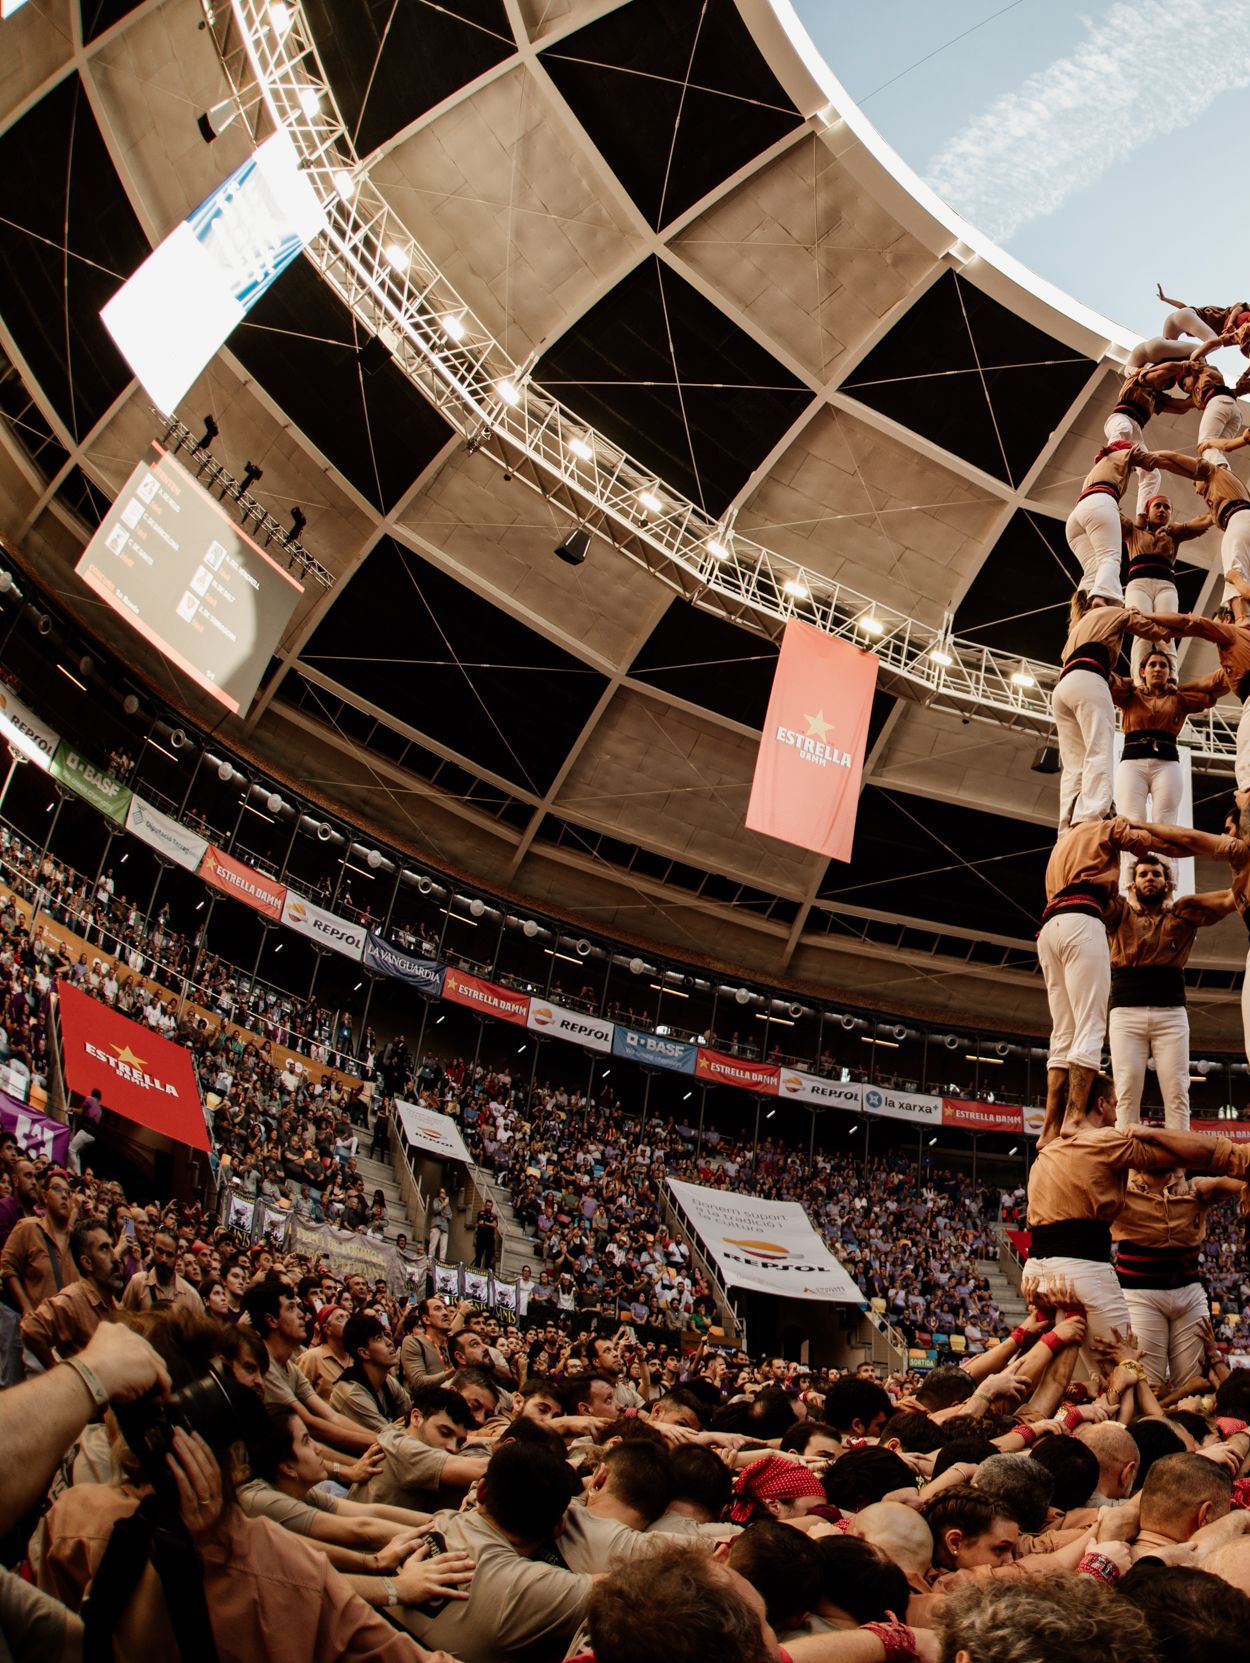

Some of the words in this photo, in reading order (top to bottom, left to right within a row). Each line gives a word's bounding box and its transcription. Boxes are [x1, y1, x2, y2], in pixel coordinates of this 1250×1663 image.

[776, 726, 851, 768] ESTRELLA
[799, 750, 827, 768] DAMM
[83, 765, 120, 797] BASF
[216, 865, 256, 895] ESTRELLA
[255, 888, 282, 909] DAMM
[312, 919, 362, 949] REPSOL
[368, 944, 380, 957] LA
[377, 948, 441, 983] VANGUARDIA
[458, 984, 498, 1007] ESTRELLA
[499, 1000, 527, 1016] DAMM
[560, 1019, 610, 1042] REPSOL
[647, 1039, 684, 1057] BASF
[85, 1041, 179, 1098] ESTRELLA
[710, 1062, 750, 1079] ESTRELLA
[751, 1073, 778, 1086] DAMM
[811, 1085, 859, 1101] REPSOL
[885, 1096, 895, 1108] la
[955, 1110, 995, 1123] ESTRELLA
[995, 1114, 1022, 1124] DAMM
[692, 1198, 741, 1215] Donem
[744, 1209, 788, 1222] suport
[725, 1212, 774, 1229] tradició
[714, 1217, 765, 1233] cultura
[723, 1251, 832, 1272] REPSOL
